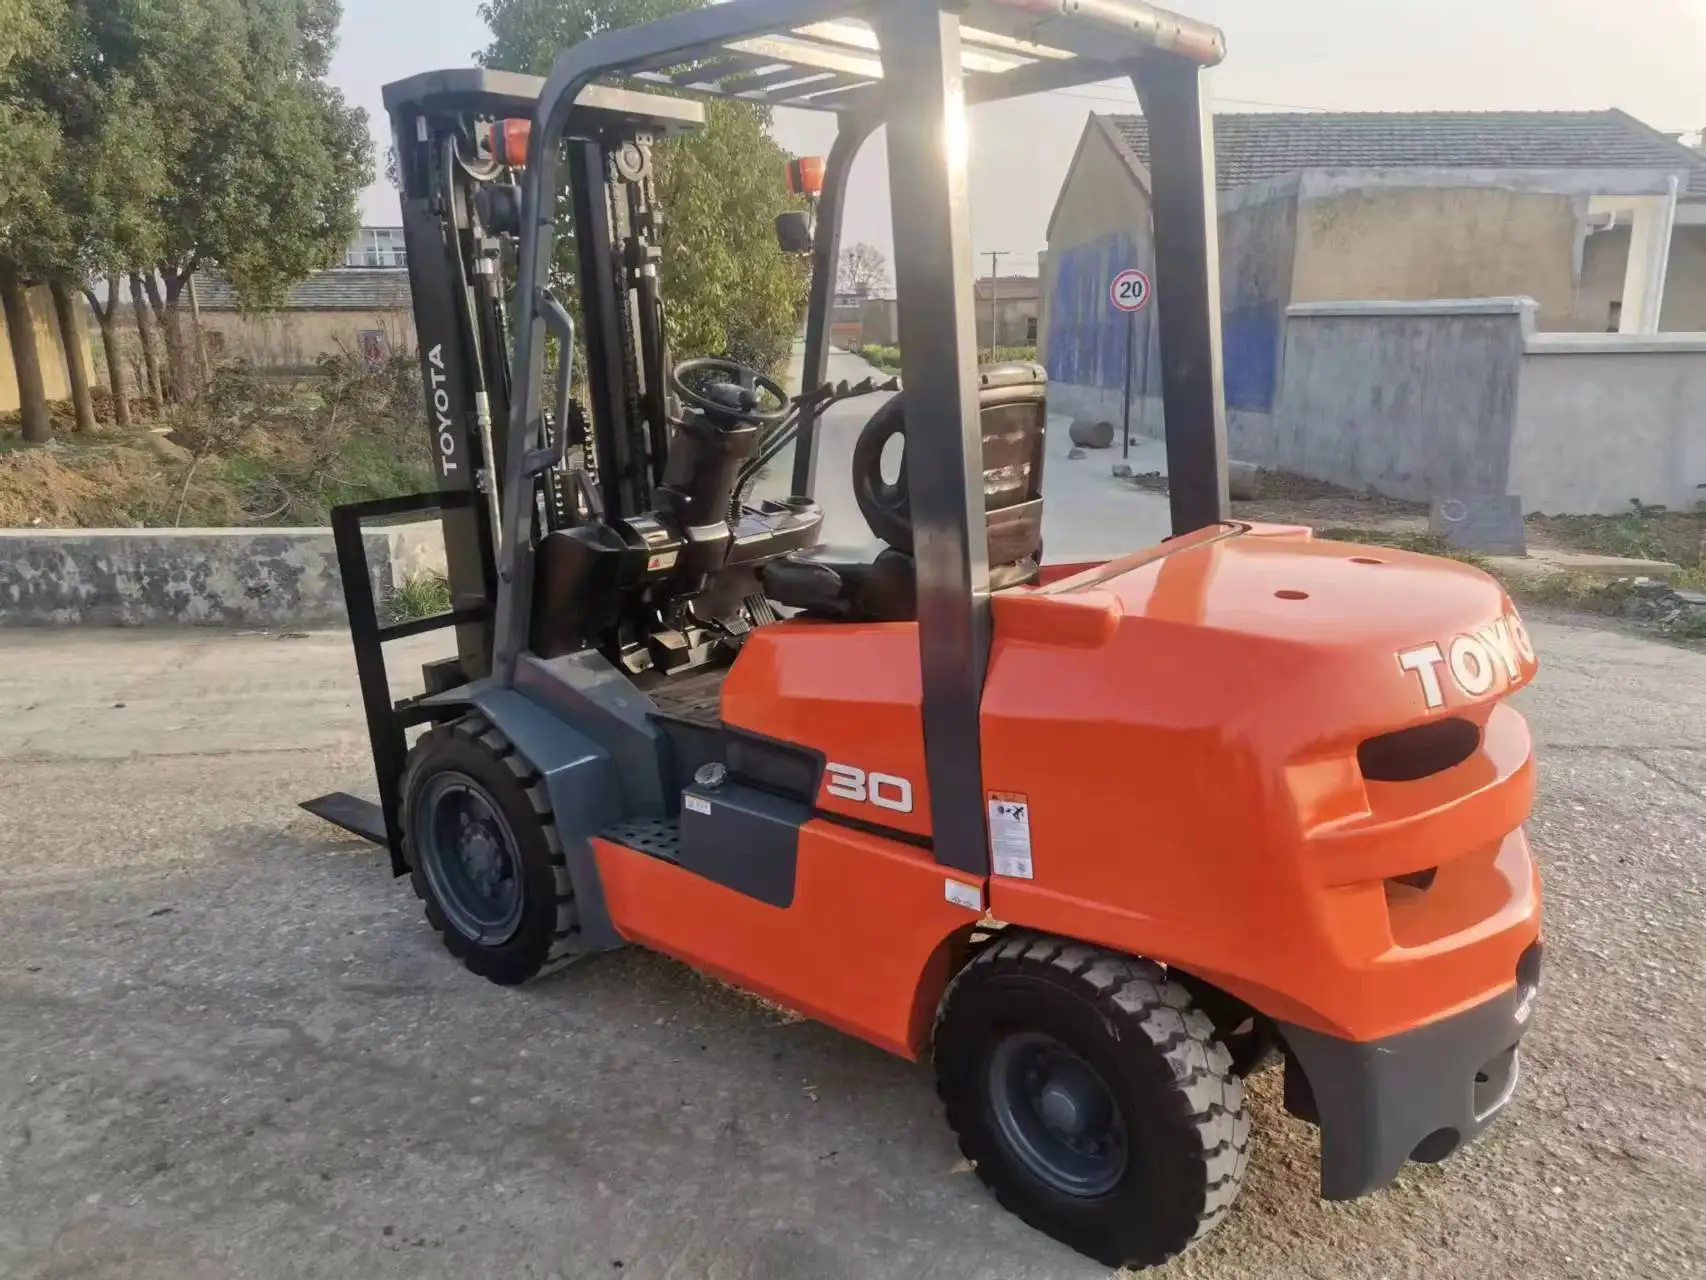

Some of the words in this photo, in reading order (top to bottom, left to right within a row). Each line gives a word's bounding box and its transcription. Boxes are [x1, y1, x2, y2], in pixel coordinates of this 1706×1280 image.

[1120, 280, 1142, 298] 20
[428, 343, 458, 476] TOYOTA
[825, 762, 913, 813] 30
